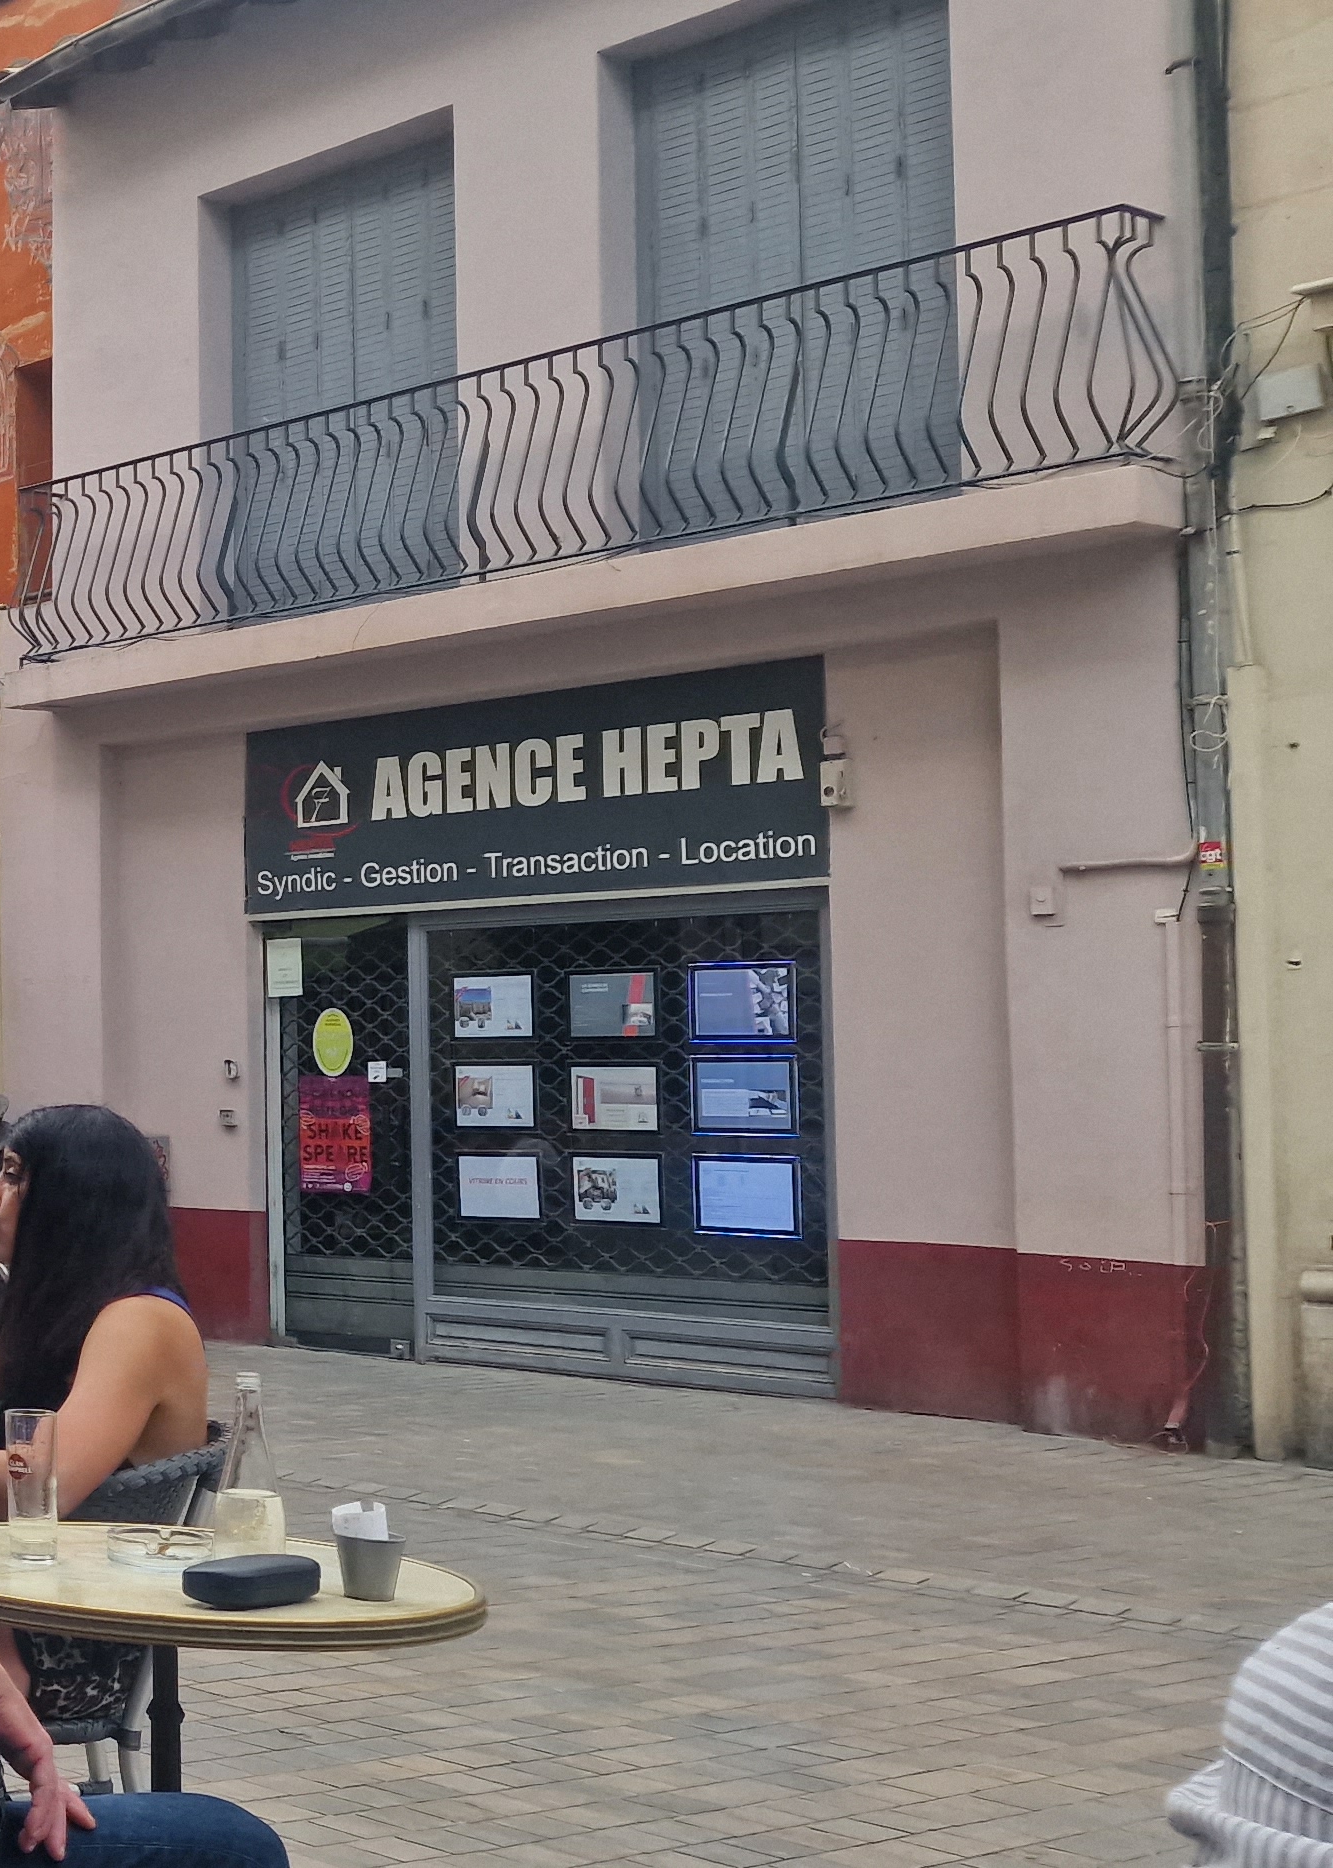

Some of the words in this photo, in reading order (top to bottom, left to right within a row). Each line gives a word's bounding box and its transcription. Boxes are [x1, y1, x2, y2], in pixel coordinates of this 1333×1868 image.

[370, 733, 587, 822] AGENCE
[601, 708, 805, 798] HEPTA
[256, 867, 337, 901] Syndic
[360, 858, 458, 888] Gestion
[482, 843, 649, 879] Transaction
[680, 830, 817, 865] Location
